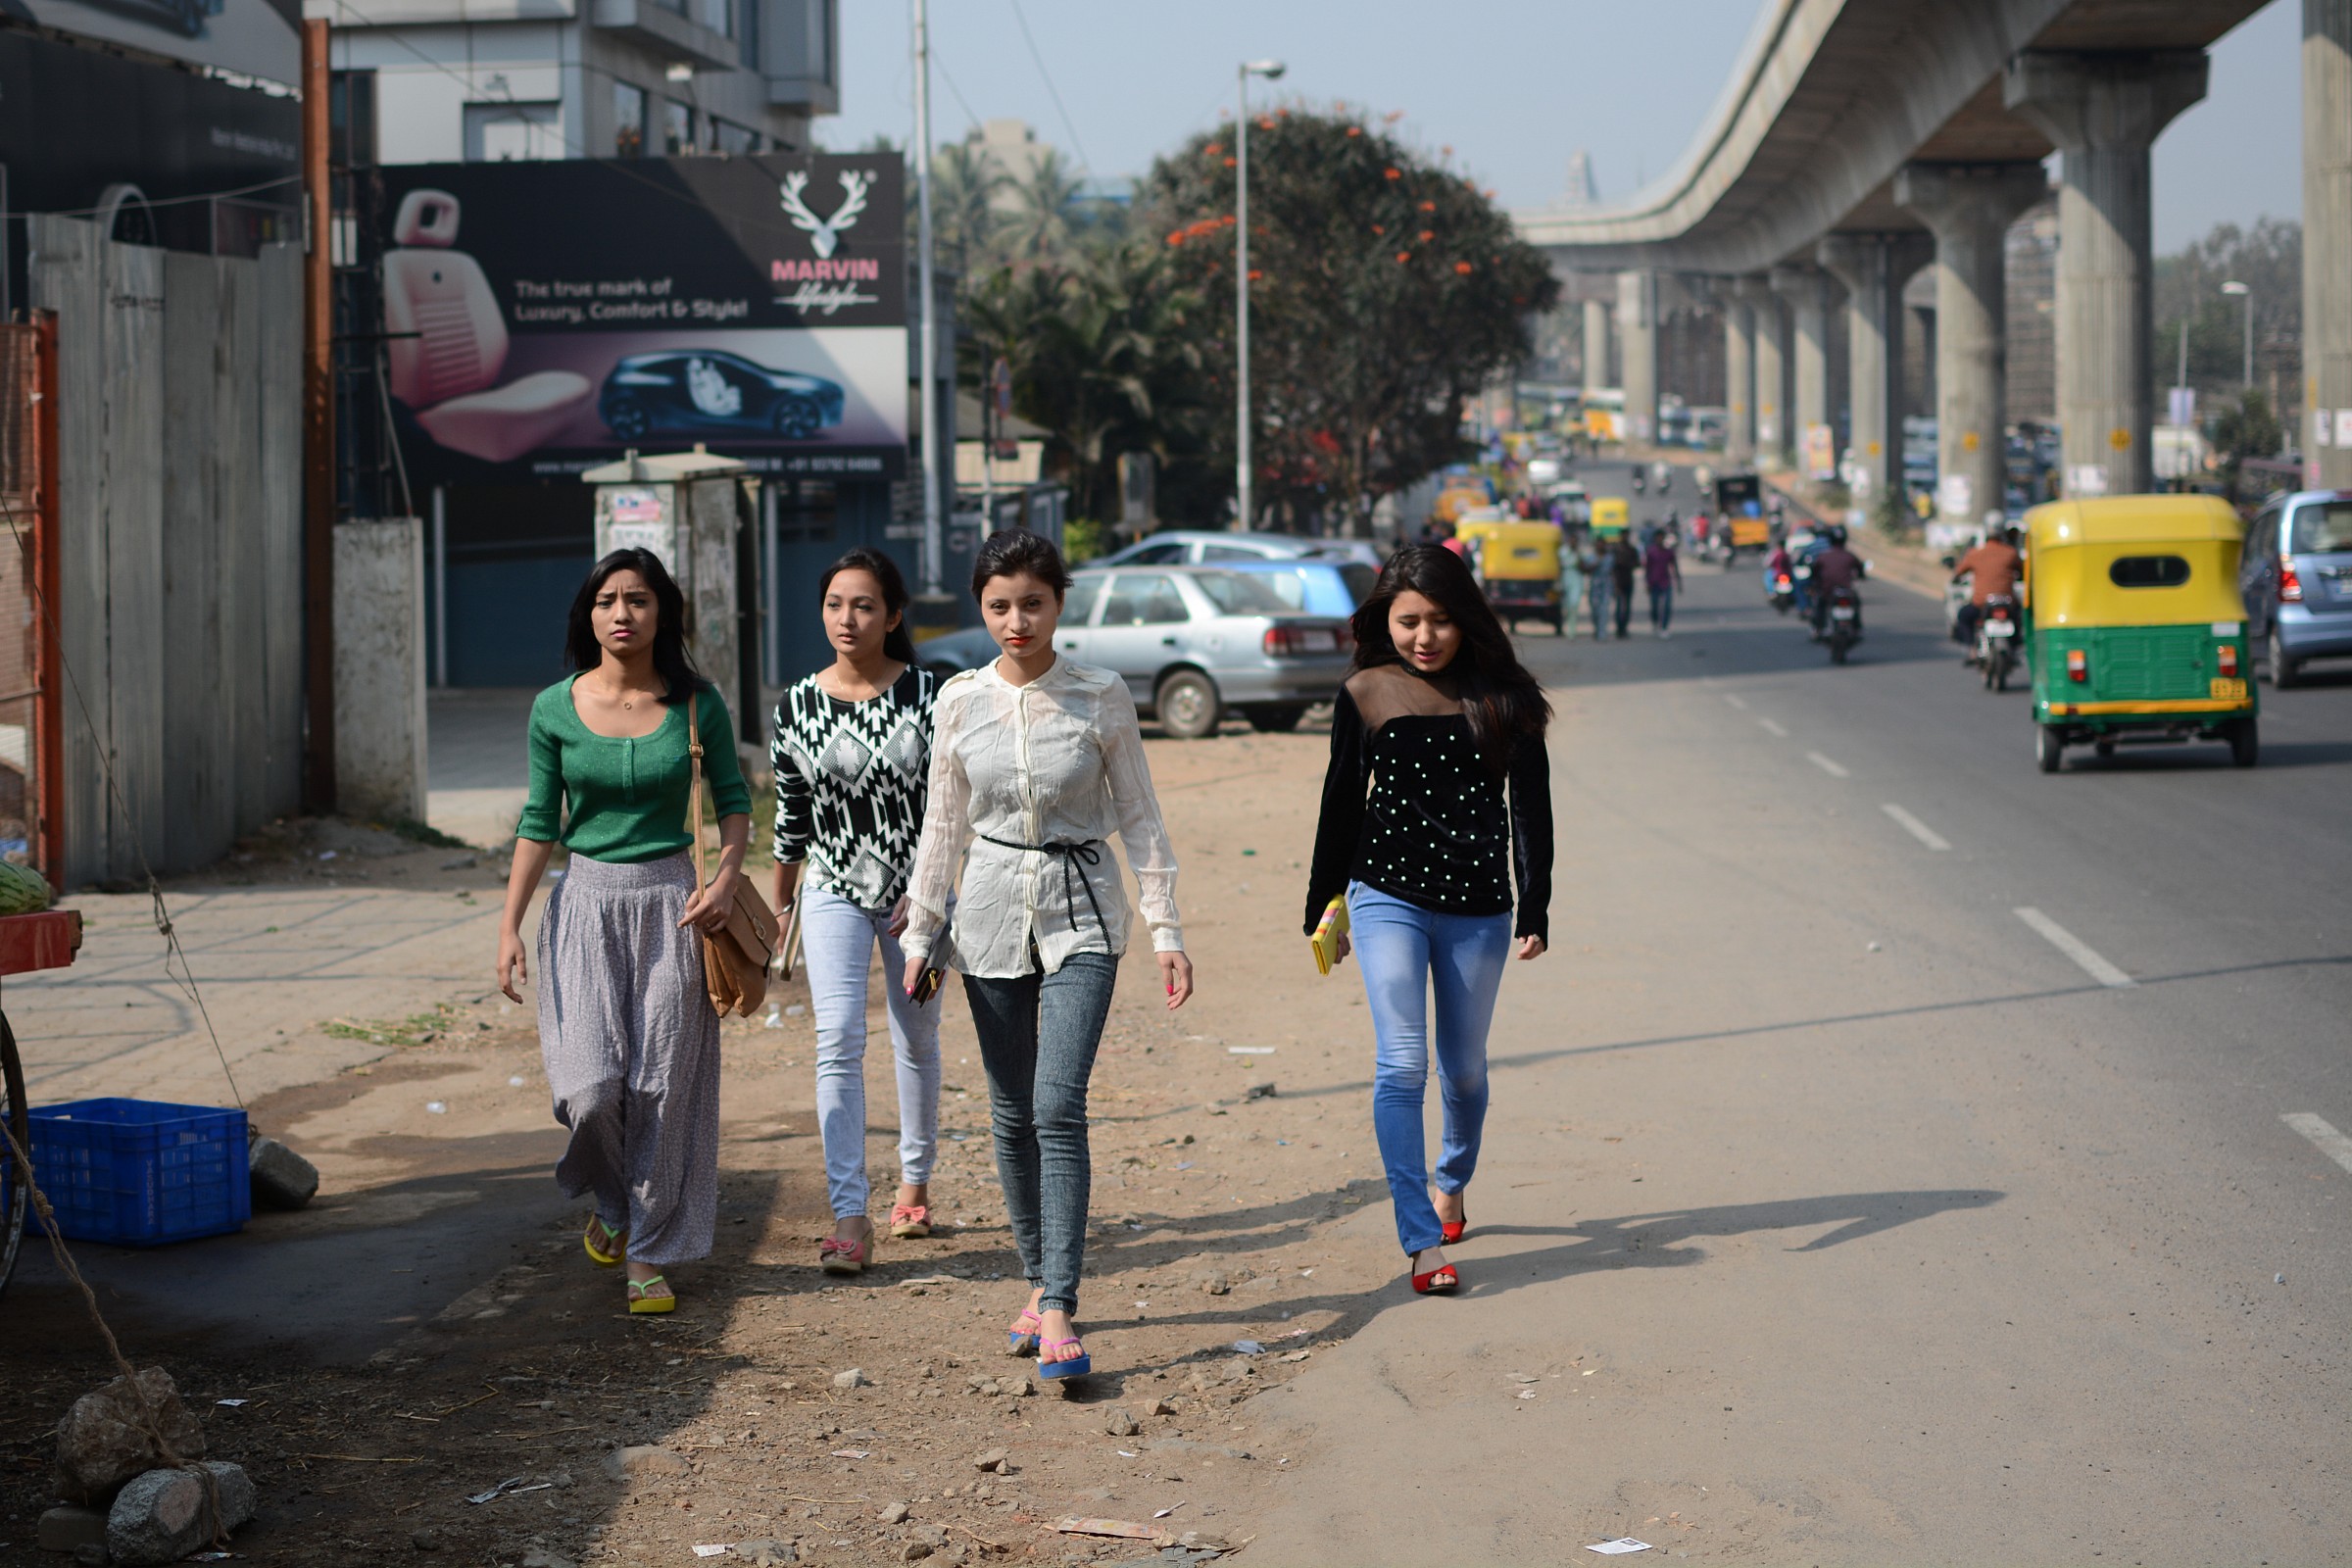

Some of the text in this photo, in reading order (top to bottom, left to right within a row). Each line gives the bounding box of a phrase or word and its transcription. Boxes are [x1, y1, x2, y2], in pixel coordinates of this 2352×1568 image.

[771, 259, 879, 280] MARVIN
[514, 277, 672, 297] The true mark of
[589, 300, 668, 319] Comfort
[671, 300, 688, 318] &
[692, 299, 749, 321] Style!
